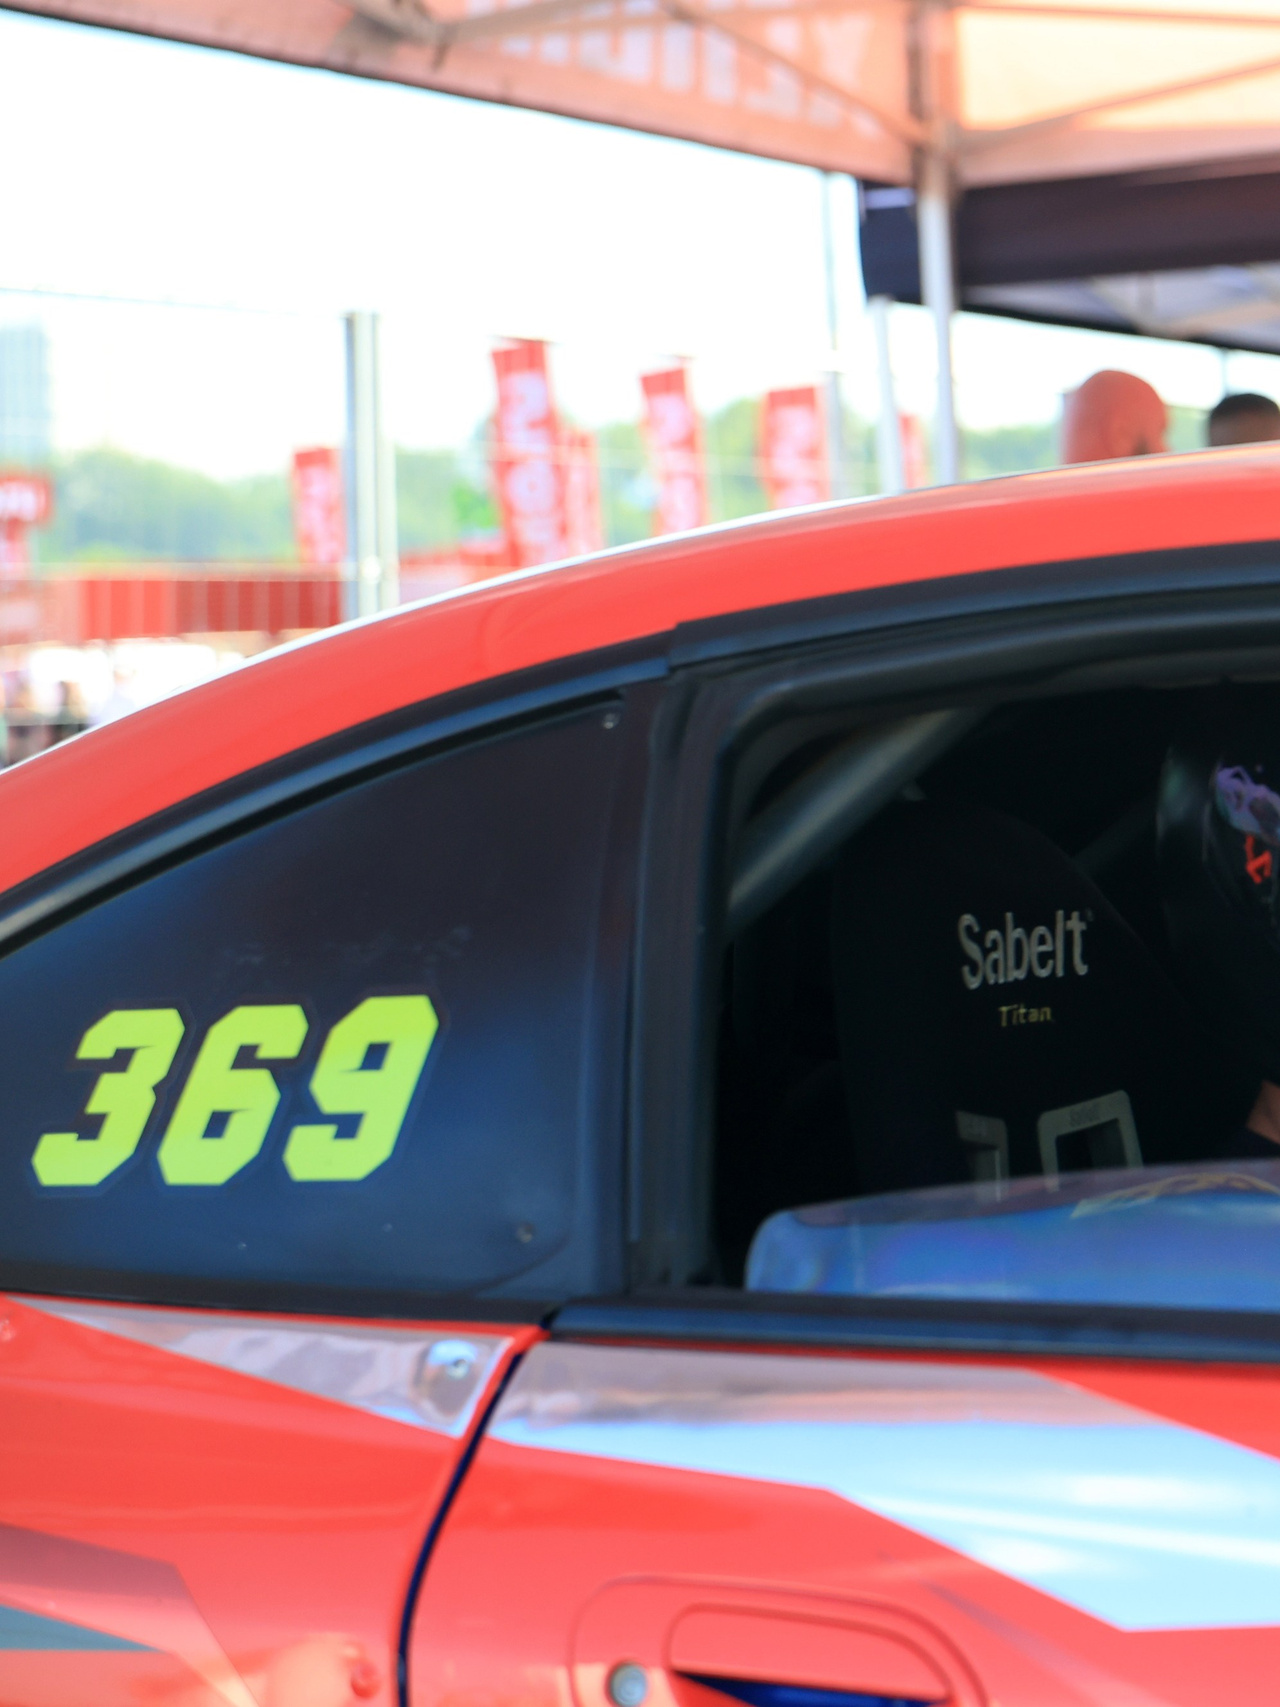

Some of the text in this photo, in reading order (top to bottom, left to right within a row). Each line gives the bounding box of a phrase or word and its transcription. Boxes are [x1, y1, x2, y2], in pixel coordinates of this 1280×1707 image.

[957, 908, 1089, 990] Sabelt
[998, 1003, 1052, 1027] Titan
[31, 994, 439, 1187] 369
